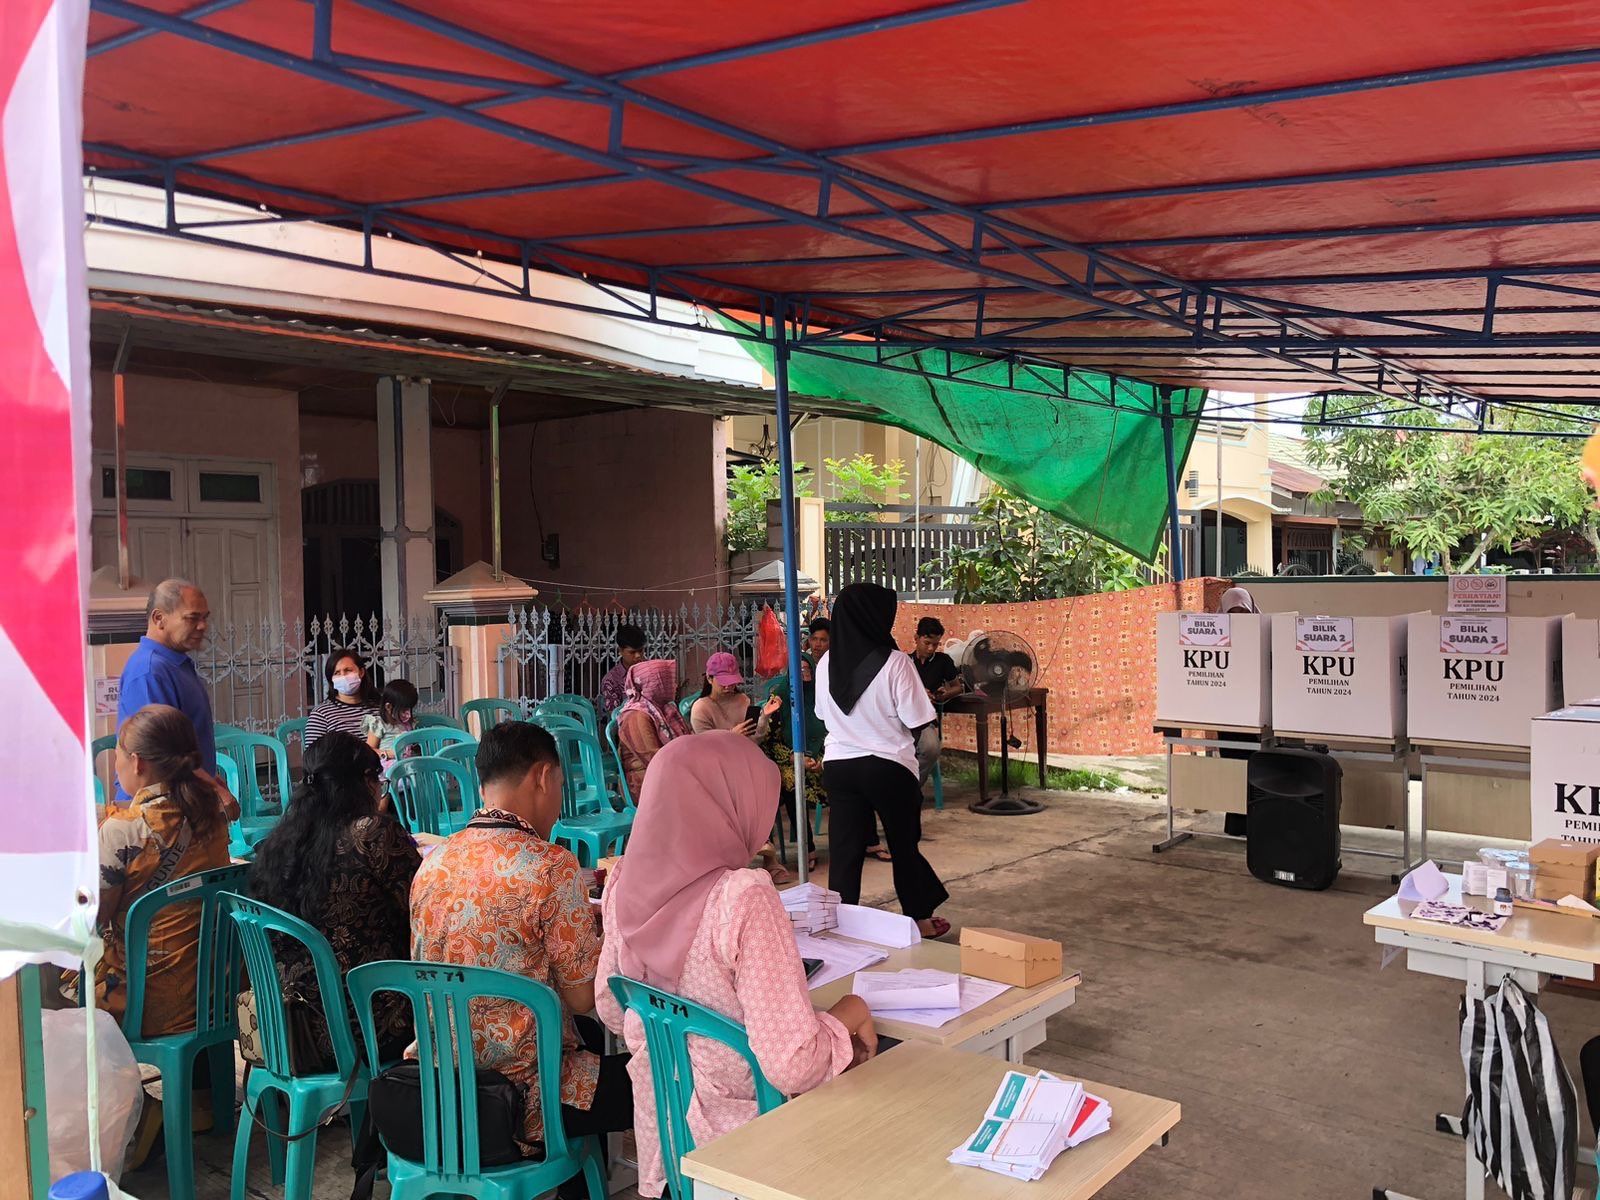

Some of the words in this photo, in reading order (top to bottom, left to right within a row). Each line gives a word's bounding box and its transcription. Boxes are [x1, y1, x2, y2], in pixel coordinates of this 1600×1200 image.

[1460, 625, 1488, 633] BILIK
[1303, 634, 1337, 642] SUARA
[1339, 634, 1346, 642] 2
[1449, 635, 1489, 643] SUARA
[1490, 636, 1498, 644] 3
[1183, 649, 1230, 669] KPU
[1302, 655, 1355, 676] KPU
[1443, 658, 1504, 681] KPU
[1308, 678, 1350, 686] PEMILIHAN
[1449, 682, 1497, 692] PEMILIHAN
[1306, 687, 1332, 695] TAHUN
[1333, 688, 1352, 696] 2024
[104, 693, 120, 701] TU
[1447, 692, 1477, 701] TAHUN
[1478, 693, 1500, 702] 2024
[1565, 819, 1600, 831] PEMI
[415, 969, 438, 981] RT
[443, 970, 465, 983] 71
[648, 993, 666, 1010] RT
[670, 1002, 689, 1018] 71
